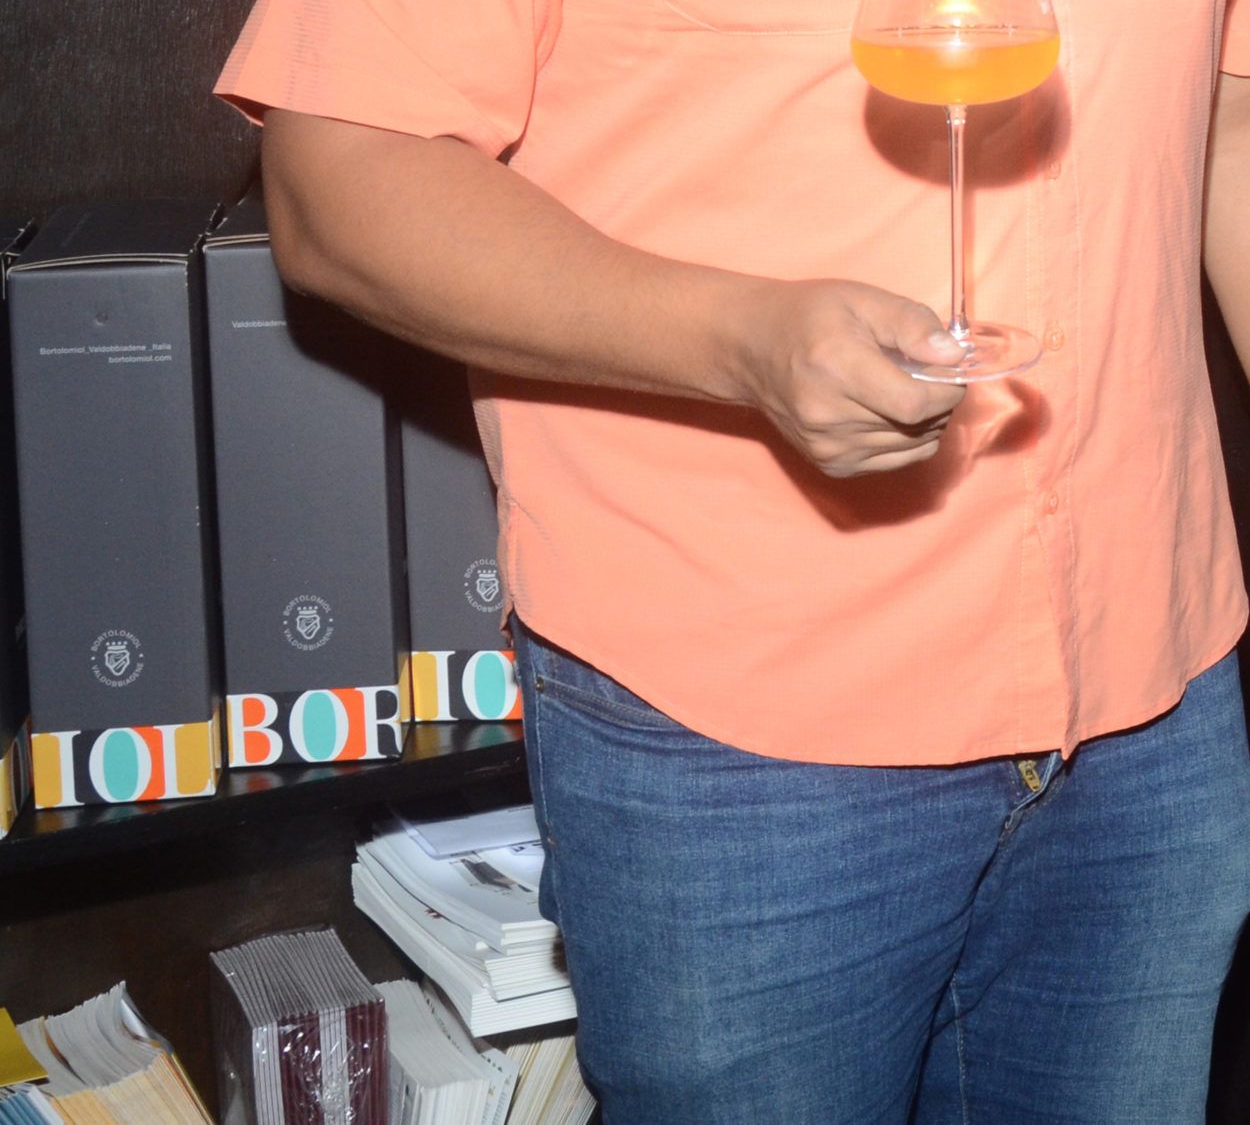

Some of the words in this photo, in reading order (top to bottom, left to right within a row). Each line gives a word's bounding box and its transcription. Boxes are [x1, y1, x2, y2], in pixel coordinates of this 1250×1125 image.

[108, 354, 172, 364] bortolomiol.com
[283, 595, 332, 616] BORTOLOMIOL
[90, 630, 142, 652] BORTOLOMIOL
[228, 685, 400, 768] BOR
